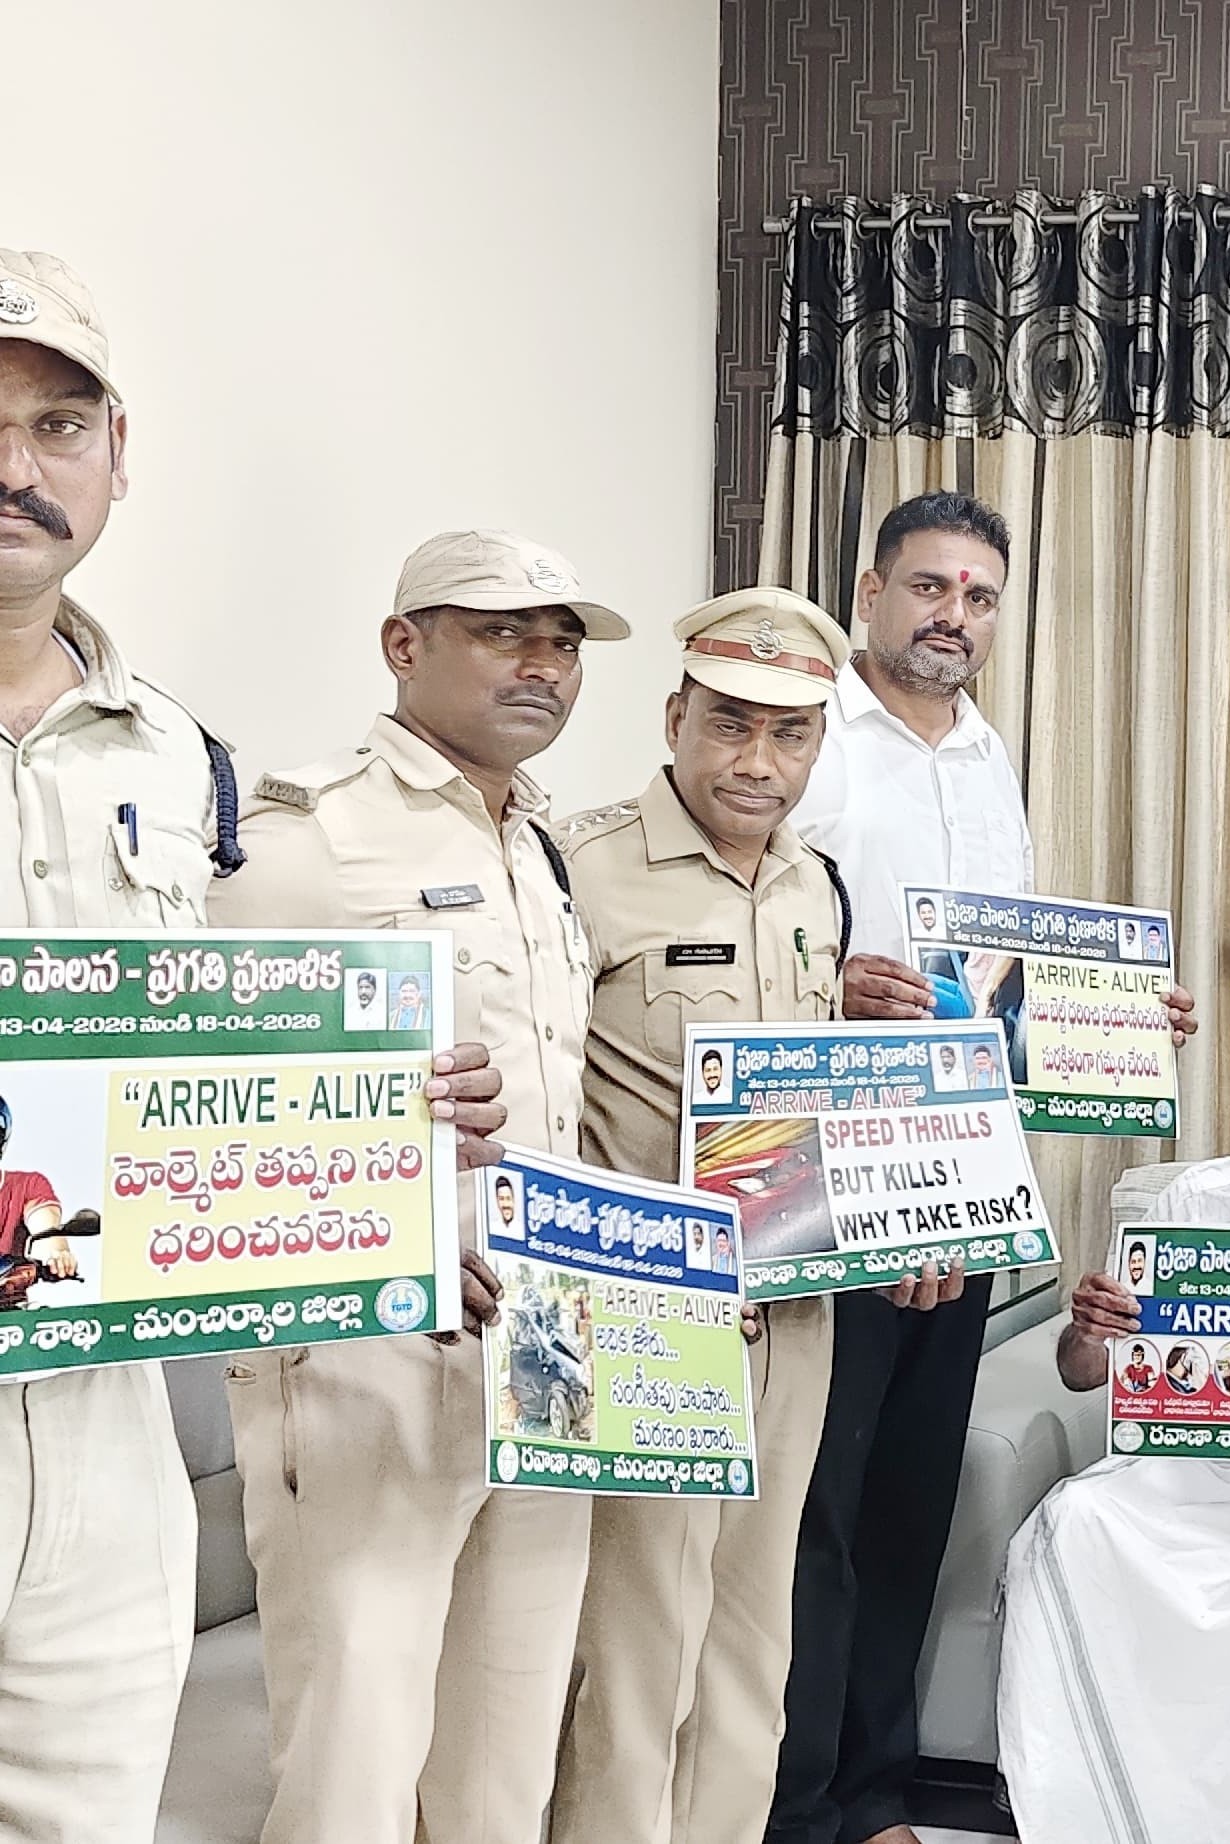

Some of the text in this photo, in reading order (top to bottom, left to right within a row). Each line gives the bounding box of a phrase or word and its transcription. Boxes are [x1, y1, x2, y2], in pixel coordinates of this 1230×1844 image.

[22, 945, 119, 994] పాలన
[147, 948, 227, 1006] ప్రగతి
[231, 947, 342, 1004] ప్రణాళిక
[196, 1014, 321, 1032] 18-04-2026
[125, 1076, 276, 1128] “ARRIVE
[308, 1072, 422, 1121] ALIVE”
[824, 1111, 992, 1149] SPEED THRILLS
[112, 1141, 423, 1212] హెల్మెట్ తప్పని సరి
[829, 1166, 874, 1196] BUT
[882, 1160, 947, 1192] KILLS
[837, 1185, 1034, 1242] WHY TAKE RISK?
[149, 1210, 392, 1273] ధరించవలెను
[1157, 1242, 1198, 1280] ప్రజా
[745, 1262, 797, 1288] వాణా
[801, 1259, 846, 1281] శాఖ
[30, 1319, 103, 1351] శాఖ
[133, 1300, 296, 1341] మంచిర్యాల
[302, 1292, 363, 1329] జిల్లా
[1149, 1424, 1212, 1448] రవాణా
